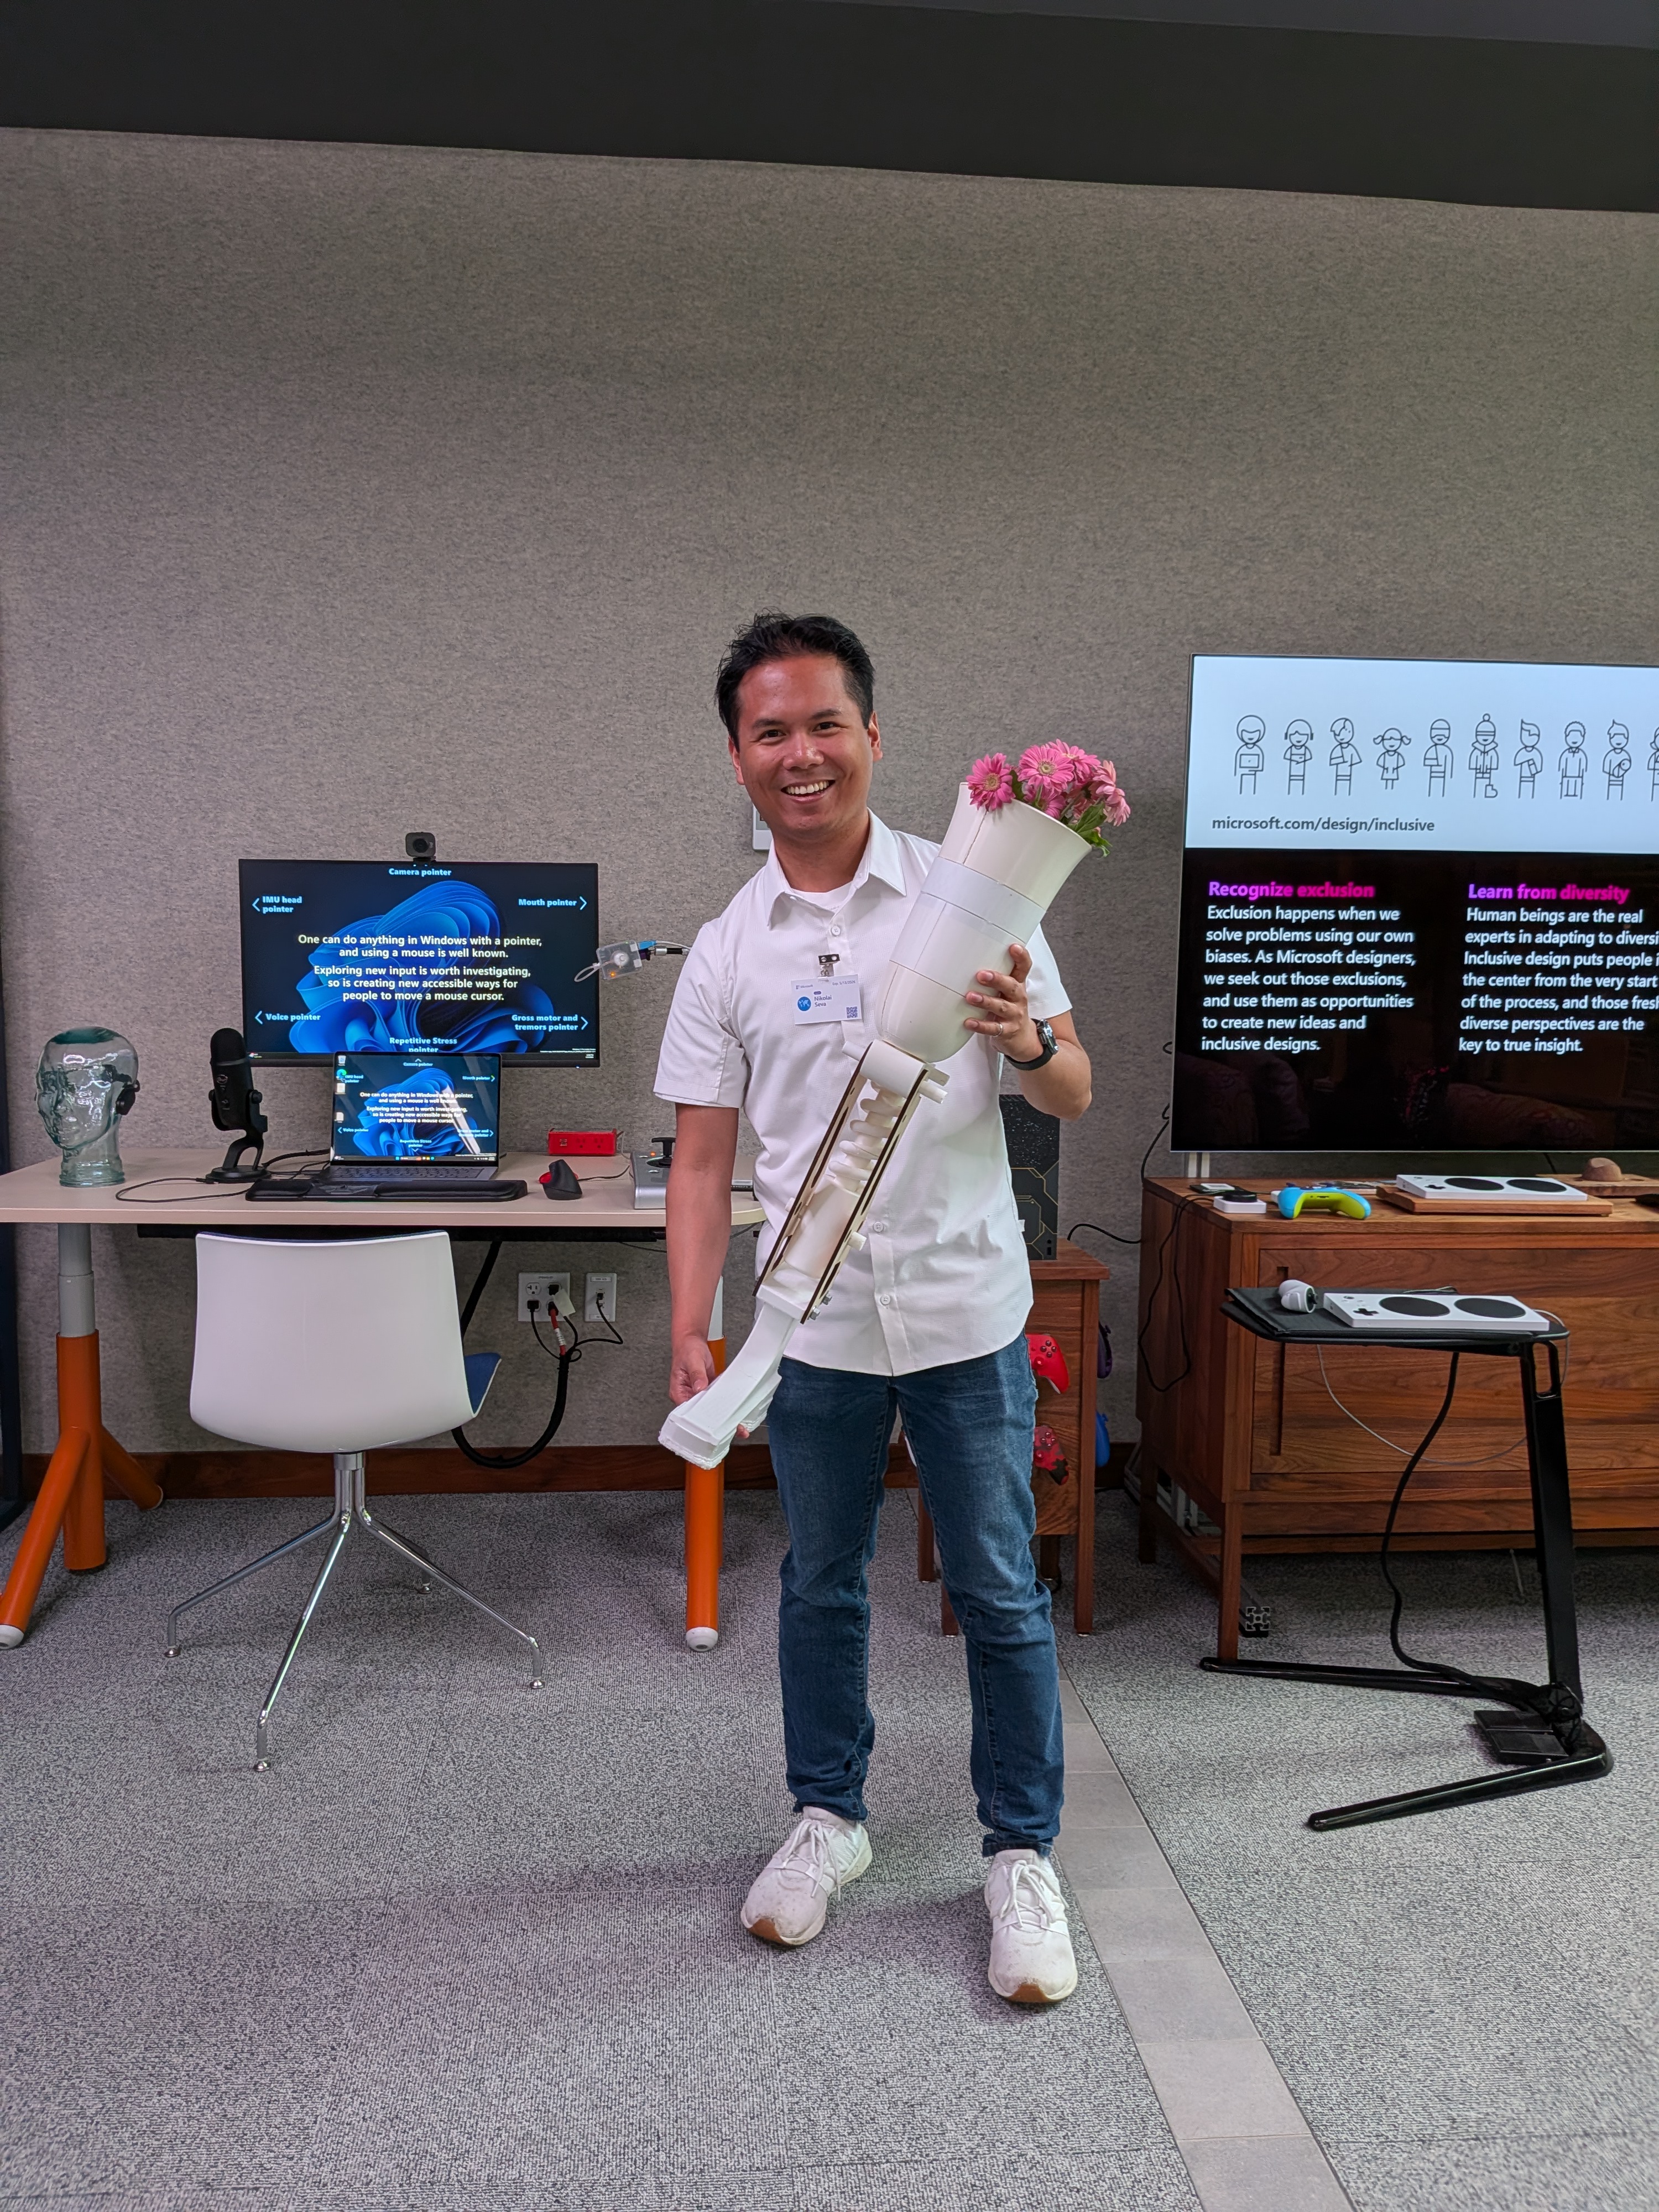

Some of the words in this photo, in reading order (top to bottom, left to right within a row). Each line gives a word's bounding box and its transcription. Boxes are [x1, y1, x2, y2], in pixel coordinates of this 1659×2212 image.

[1212, 816, 1434, 833] microsoft.com/design/inclusive
[421, 868, 452, 877] pointer
[1209, 881, 1293, 901] Recognize
[1297, 881, 1374, 898] exclusion
[1468, 884, 1513, 899] Learn
[1517, 883, 1557, 900] from
[1559, 884, 1630, 905] diversity
[262, 905, 294, 914] pointer
[547, 899, 577, 907] pointer
[1207, 905, 1272, 920] Exclusion
[1275, 905, 1335, 924] happens
[1338, 906, 1376, 921] when
[1379, 910, 1400, 921] we
[1467, 907, 1517, 922] Human
[1519, 907, 1566, 926] beings
[1567, 911, 1590, 922] are
[1592, 908, 1615, 923] the
[1618, 909, 1644, 924] real
[298, 934, 320, 943] One
[343, 935, 357, 944] do
[359, 935, 405, 947] anything
[408, 935, 418, 945] in
[420, 935, 467, 945] Windows
[469, 936, 492, 945] with
[504, 936, 542, 947] pointer,
[1206, 927, 1243, 941] solve
[1245, 927, 1312, 945] problems
[1315, 927, 1354, 946] using
[1356, 931, 1383, 942] our
[1383, 932, 1414, 942] own
[1465, 931, 1516, 947] experts
[1518, 928, 1532, 943] in
[1535, 929, 1595, 948] adapting
[1598, 932, 1613, 945] to
[339, 947, 358, 957] and
[362, 947, 389, 959] using
[438, 948, 446, 957] is
[448, 948, 469, 957] well
[472, 948, 508, 958] known.
[1206, 948, 1253, 963] biases.
[1254, 950, 1274, 963] As
[1276, 949, 1344, 964] Microsoft
[1345, 950, 1416, 968] designers,
[1464, 950, 1523, 965] Inclusive
[1525, 951, 1571, 969] design
[1573, 953, 1604, 969] puts
[1606, 952, 1653, 970] people
[314, 965, 362, 977] Exploring
[389, 966, 416, 977] input
[419, 966, 427, 975] is
[430, 966, 460, 975] worth
[463, 966, 531, 978] investigating,
[1203, 974, 1225, 985] we
[1227, 971, 1260, 985] seek
[1262, 973, 1288, 985] out
[1290, 971, 1330, 985] those
[1332, 971, 1407, 988] exclusions,
[342, 978, 351, 987] is
[353, 978, 395, 990] creating
[422, 978, 473, 988] accessible
[475, 981, 500, 990] ways
[503, 979, 518, 988] for
[1462, 972, 1486, 987] the
[1488, 974, 1532, 987] center
[1534, 972, 1567, 987] from
[1569, 973, 1593, 987] the
[1594, 977, 1625, 991] very
[1626, 975, 1658, 988] start
[343, 990, 378, 1002] people
[380, 992, 392, 1000] to
[1203, 993, 1231, 1007] and
[1233, 997, 1259, 1007] use
[1260, 993, 1298, 1008] them
[1301, 997, 1317, 1008] as
[1319, 993, 1414, 1011] opportunities
[1461, 994, 1478, 1008] of
[1478, 994, 1503, 1009] the
[1504, 998, 1559, 1012] process,
[1562, 994, 1589, 1009] and
[1591, 995, 1629, 1009] those
[290, 1013, 321, 1022] pointer
[1202, 1016, 1218, 1029] to
[1220, 1016, 1265, 1029] create
[1267, 1019, 1297, 1029] new
[1299, 1015, 1337, 1029] ideas
[1338, 1015, 1367, 1029] and
[1459, 1015, 1509, 1030] diverse
[1511, 1016, 1595, 1034] perspectives
[1597, 1020, 1620, 1030] are
[1621, 1016, 1645, 1031] the
[548, 1023, 578, 1032] pointer
[389, 1037, 431, 1046] Repetitive
[1201, 1036, 1261, 1051] inclusive
[1264, 1036, 1321, 1054] designs.
[1458, 1036, 1484, 1055] key
[1485, 1039, 1501, 1051] to
[1503, 1039, 1532, 1051] true
[1534, 1037, 1584, 1055] insight.
